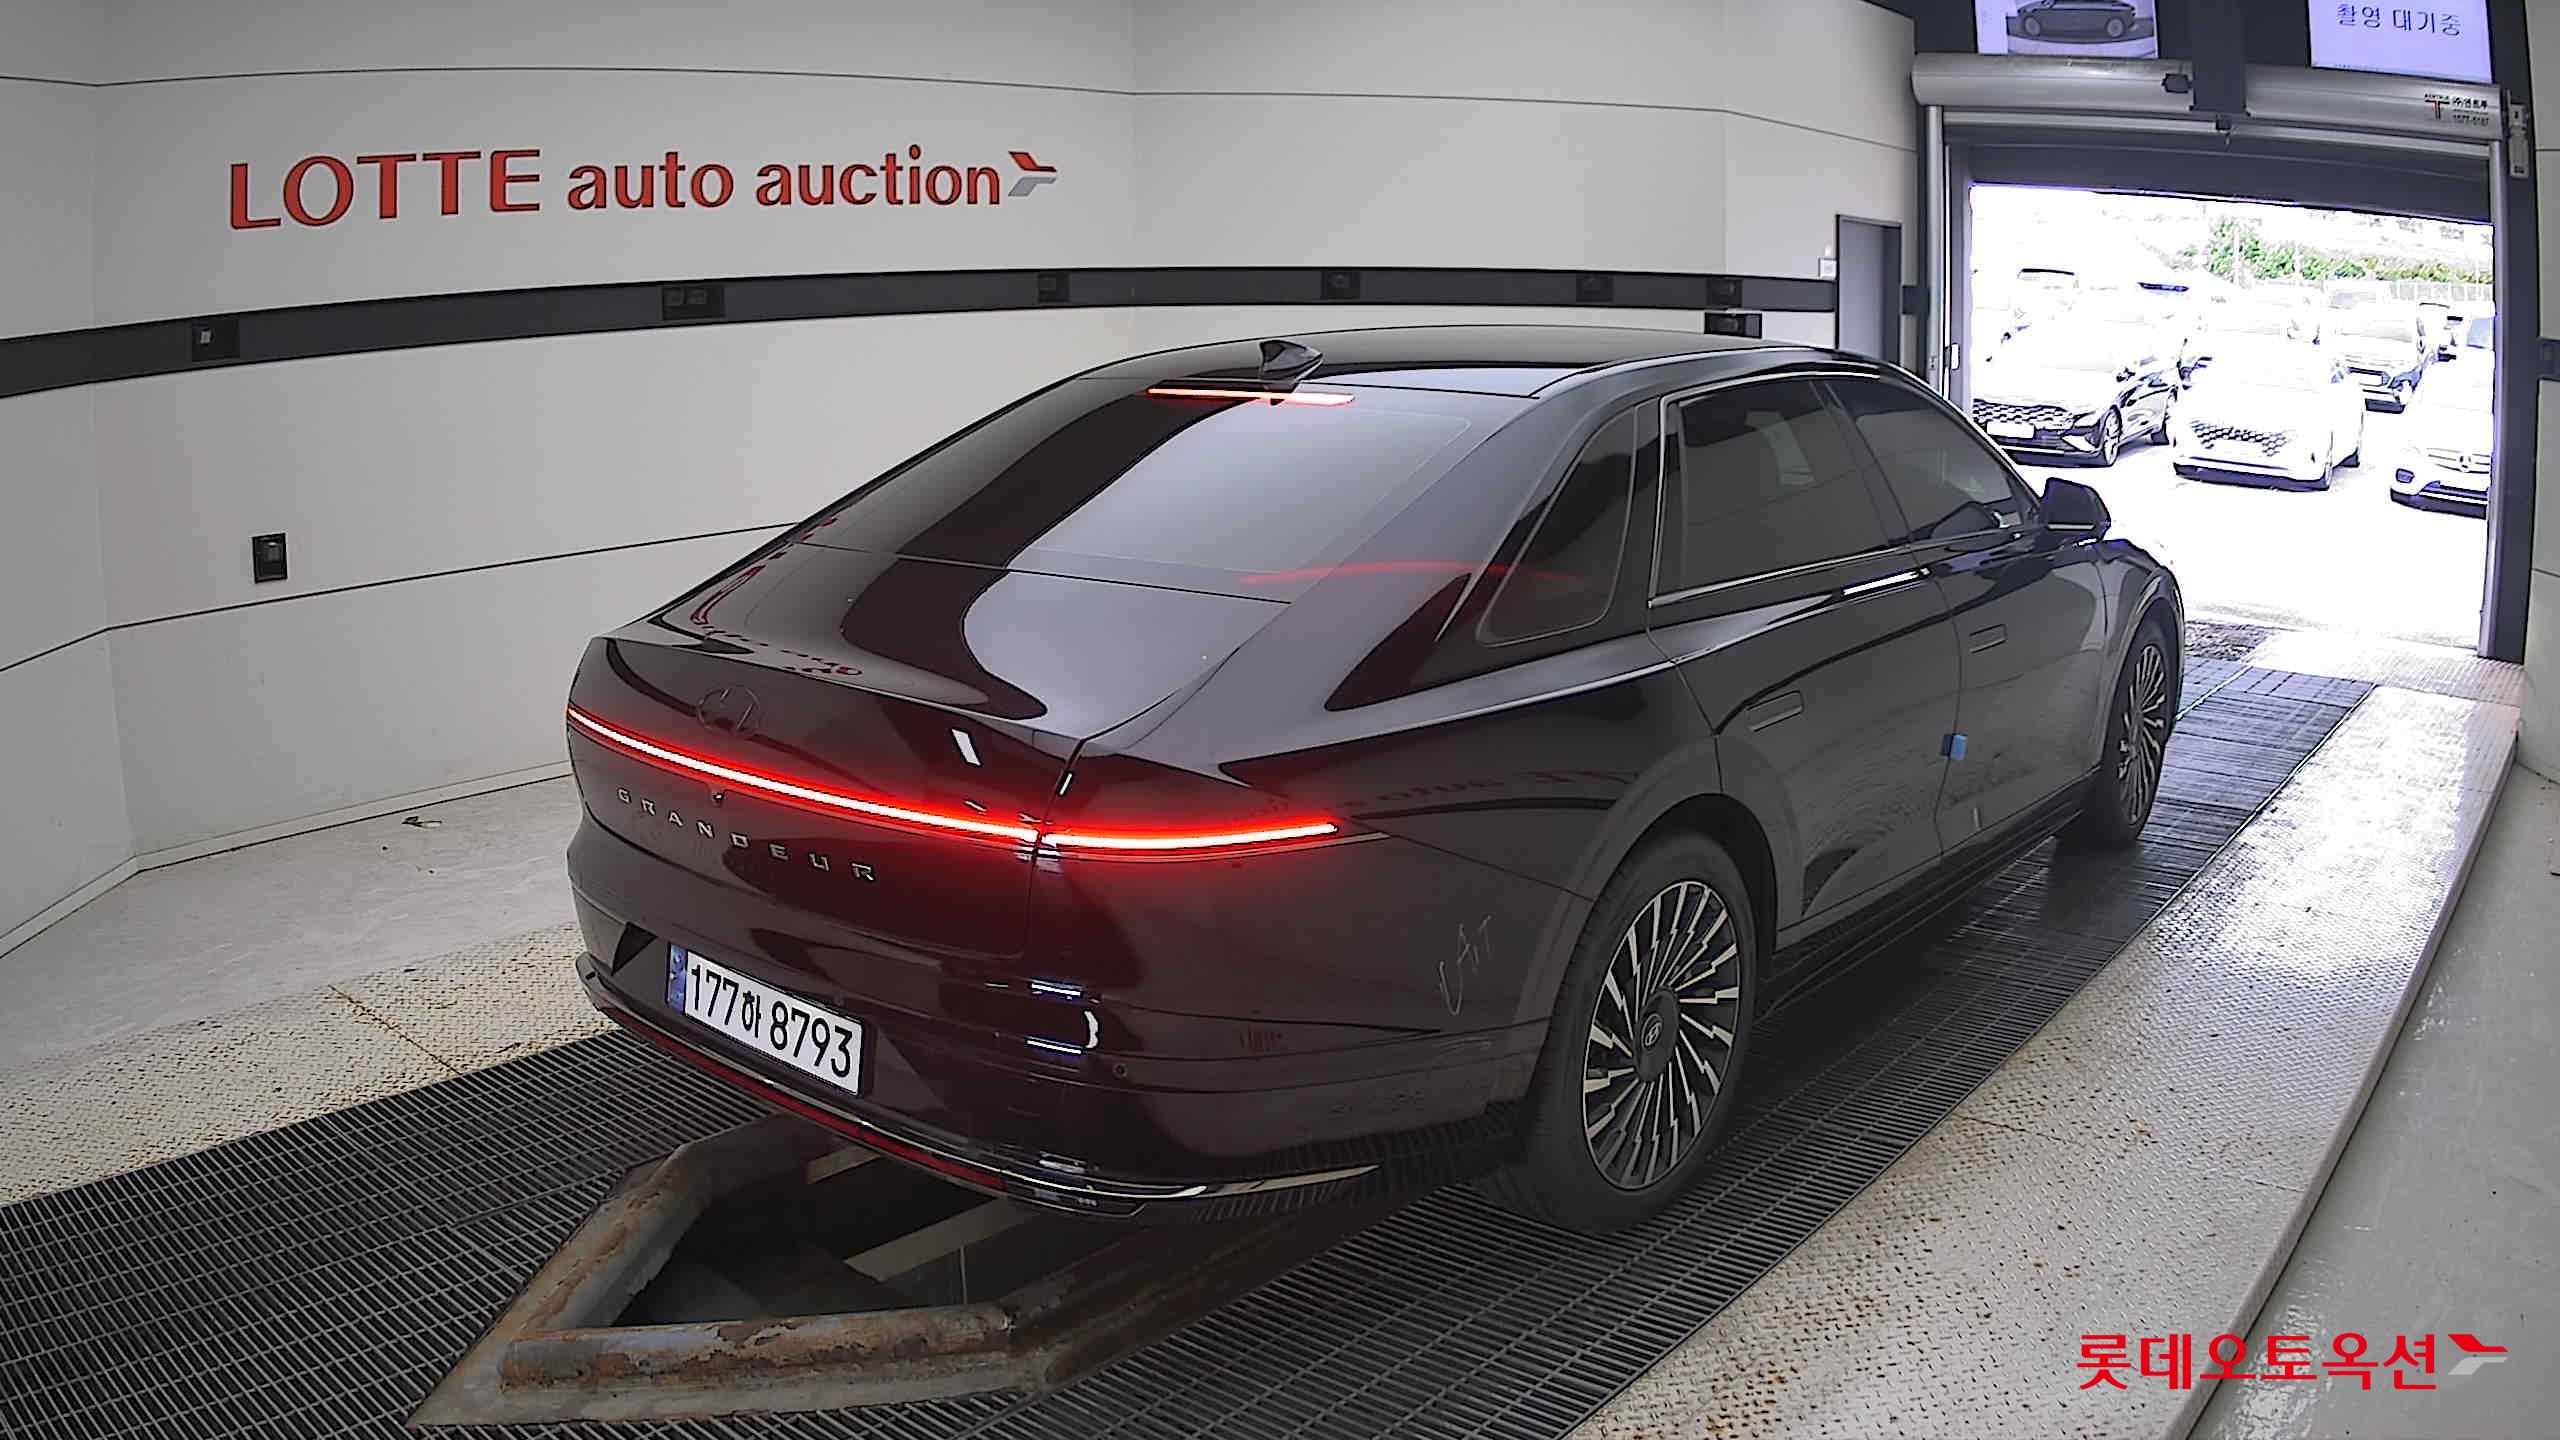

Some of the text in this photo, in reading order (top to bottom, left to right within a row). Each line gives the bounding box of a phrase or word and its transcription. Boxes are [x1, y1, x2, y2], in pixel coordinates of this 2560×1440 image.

[2392, 9, 2460, 36] 대기중
[230, 145, 1002, 229] LOTTE auto auction
[617, 788, 875, 881] GRANDEUR
[770, 1001, 853, 1078] 8793
